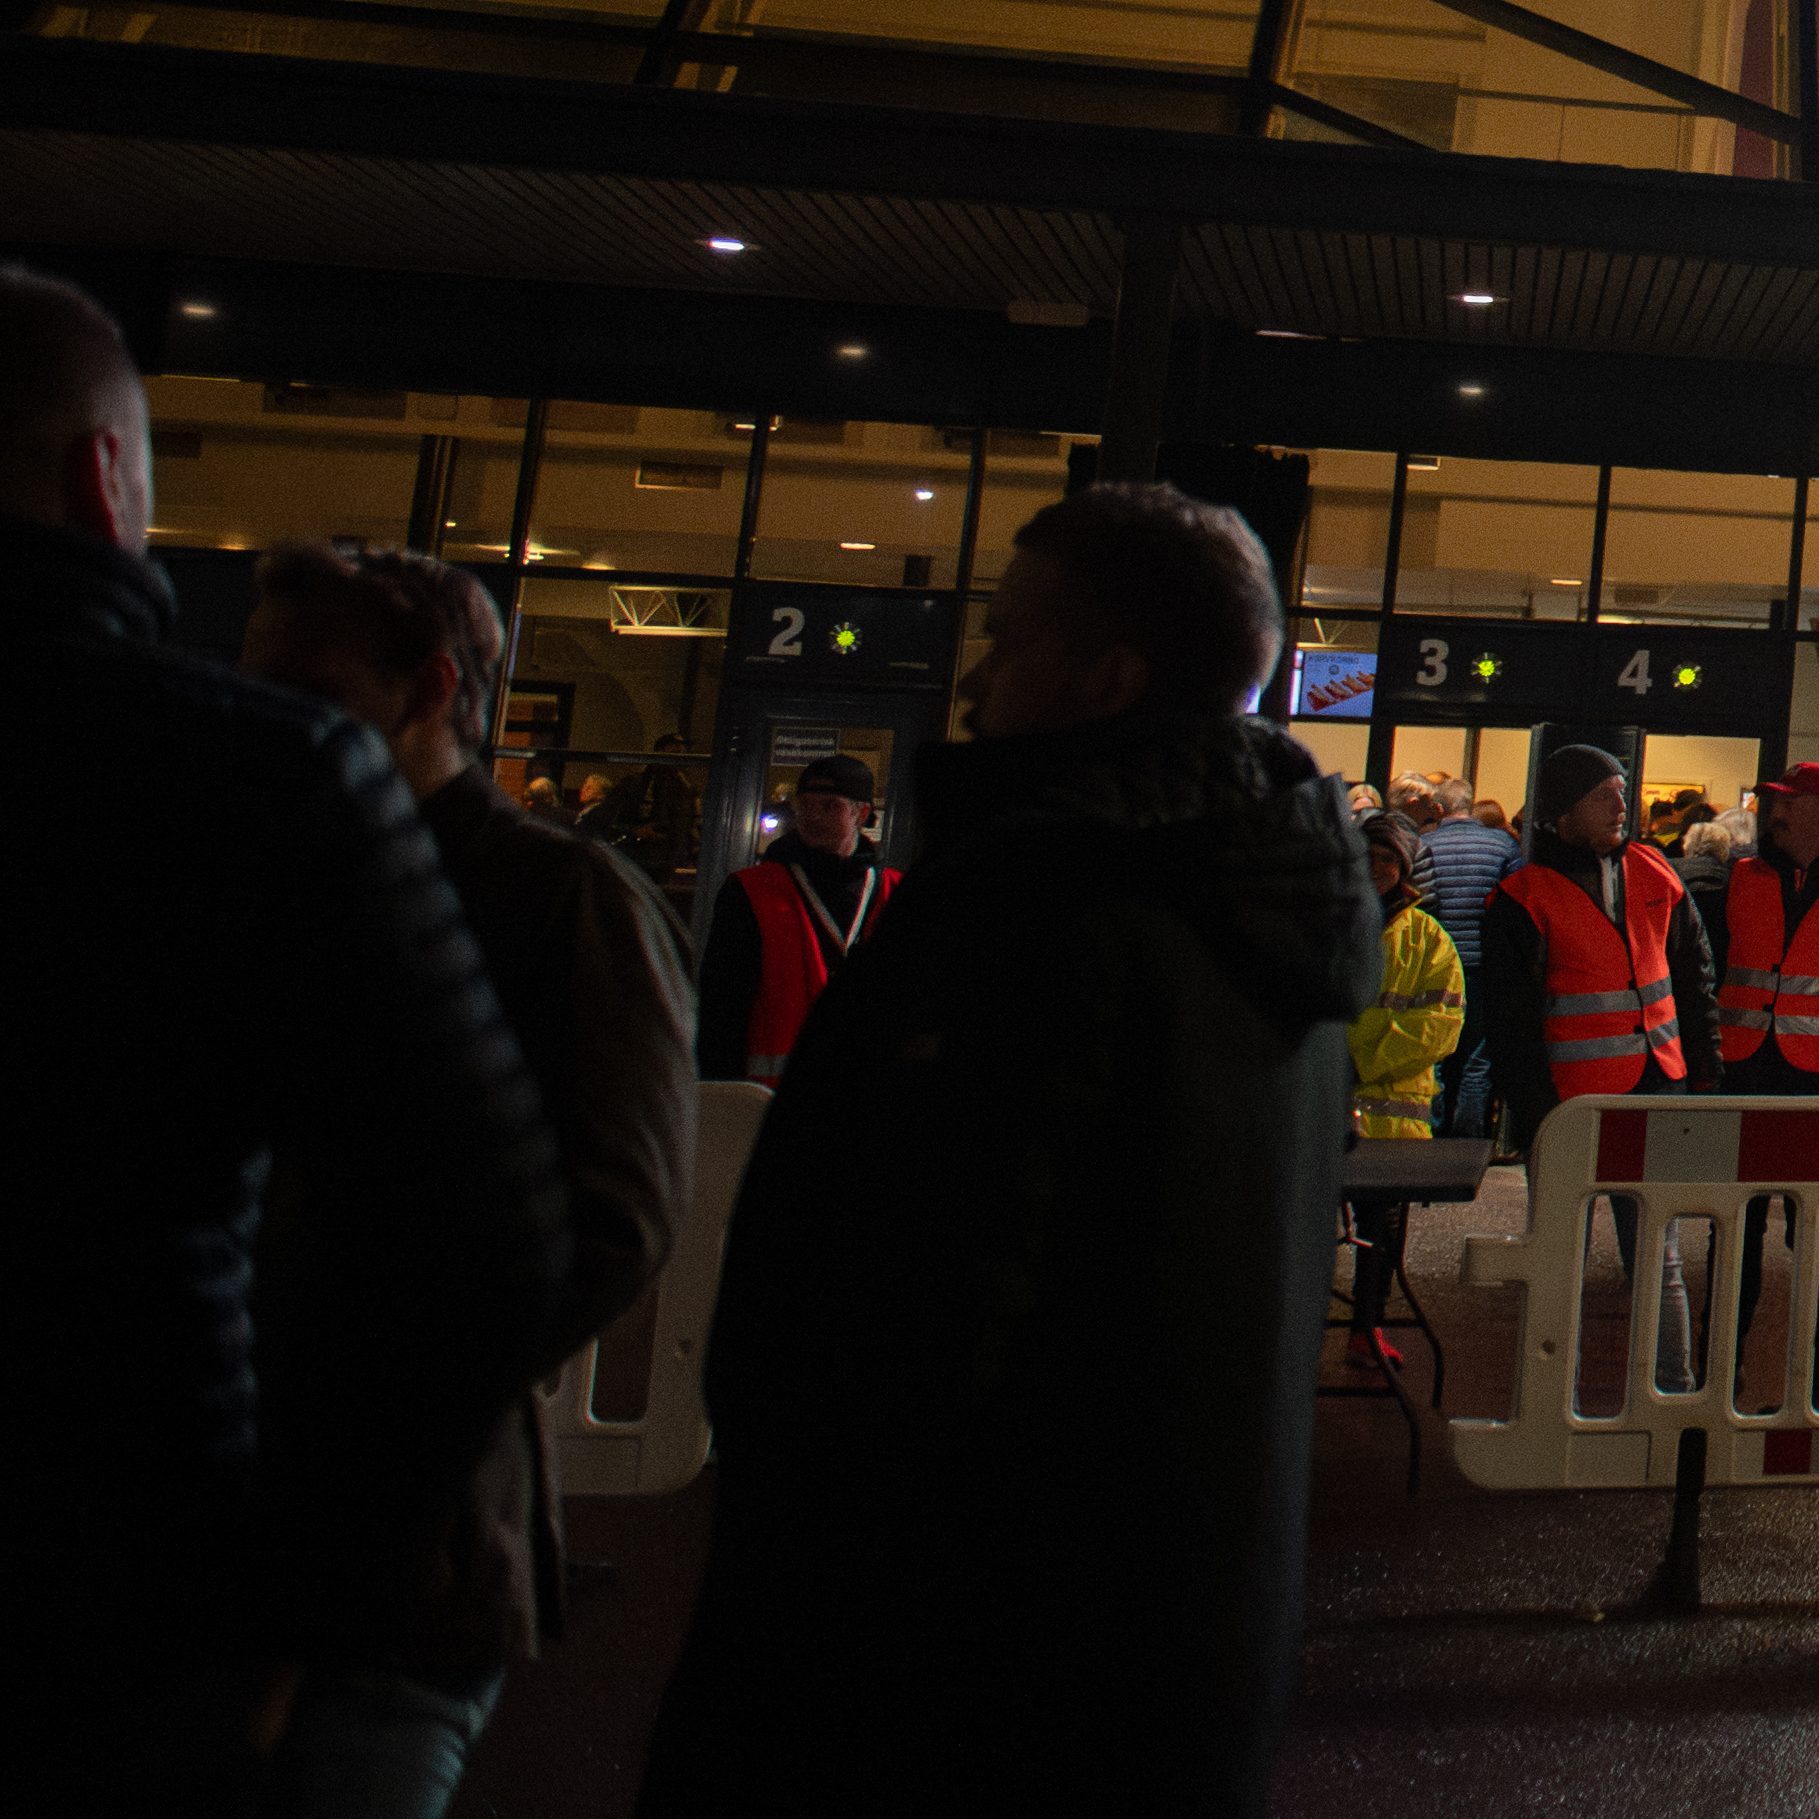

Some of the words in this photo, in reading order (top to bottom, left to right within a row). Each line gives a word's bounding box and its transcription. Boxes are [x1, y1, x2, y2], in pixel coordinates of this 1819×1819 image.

[770, 608, 805, 657] 2
[1416, 639, 1449, 686] 3
[1617, 650, 1652, 695] 4
